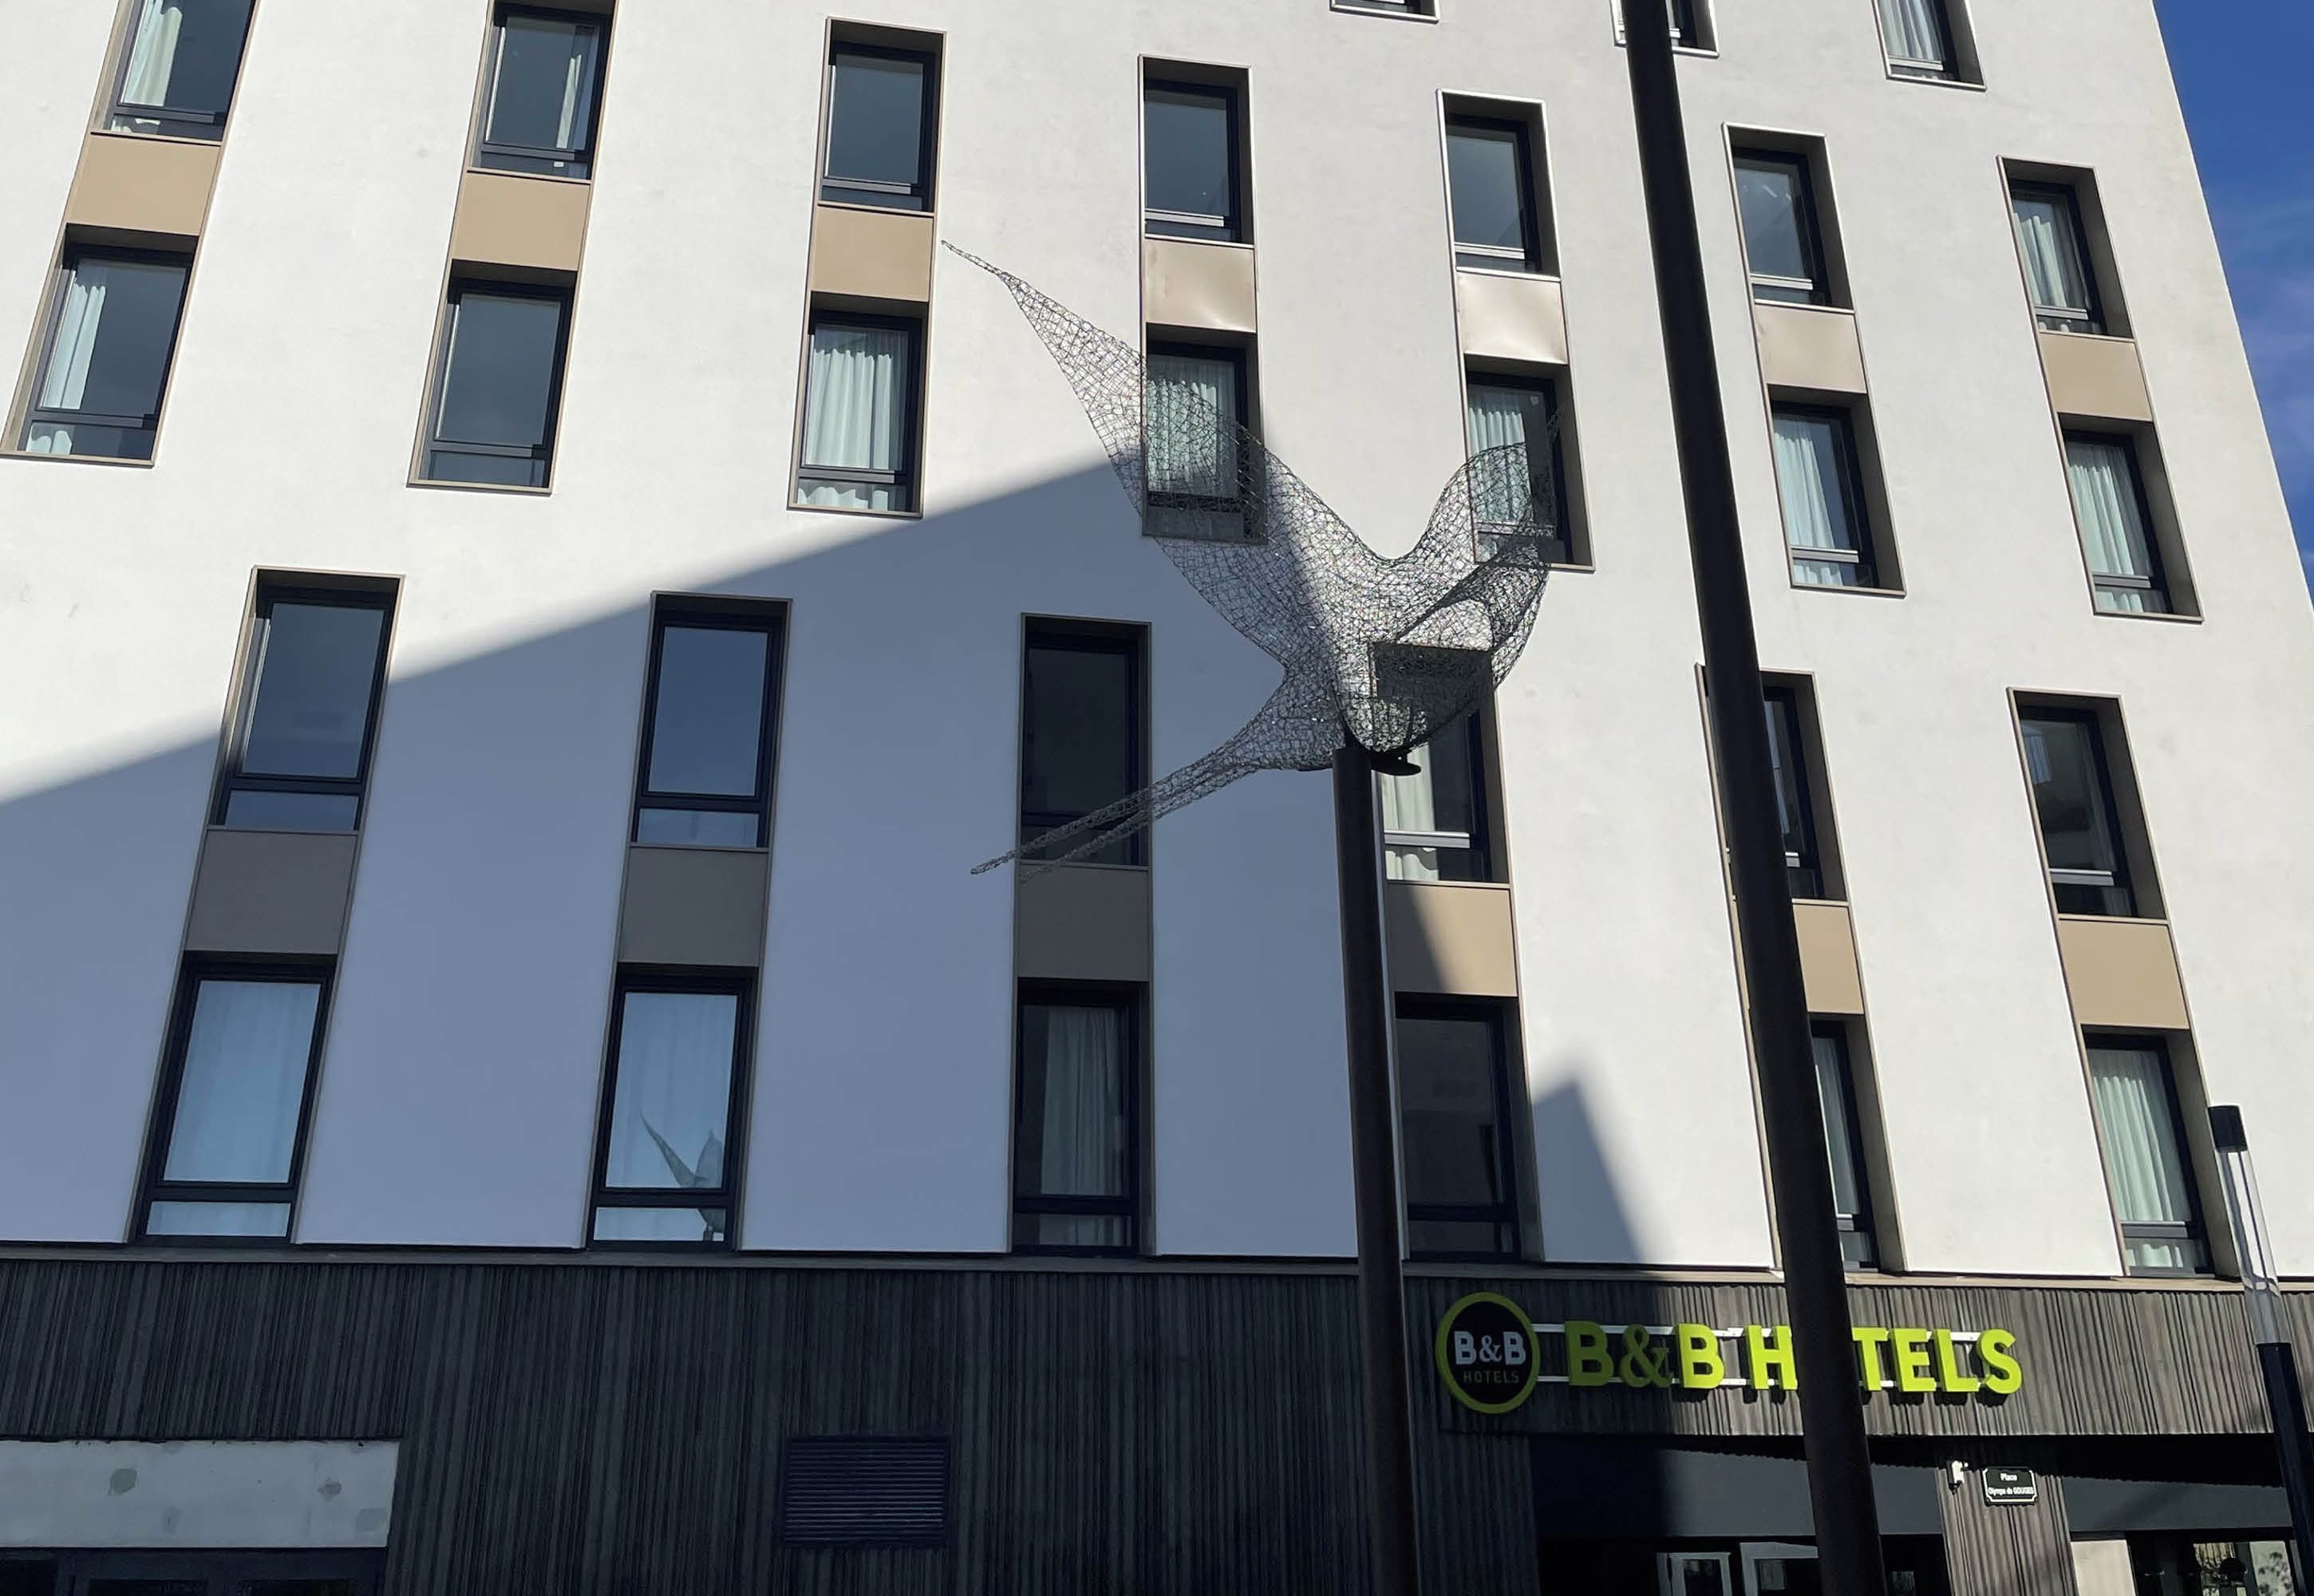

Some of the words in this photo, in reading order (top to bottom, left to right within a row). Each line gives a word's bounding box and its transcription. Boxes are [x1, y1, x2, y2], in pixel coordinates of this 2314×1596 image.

[1454, 1330, 1526, 1365] B&B
[1564, 1321, 1724, 1389] B&B
[1746, 1324, 2023, 1394] HTELS
[1463, 1370, 1519, 1384] HOTELS
